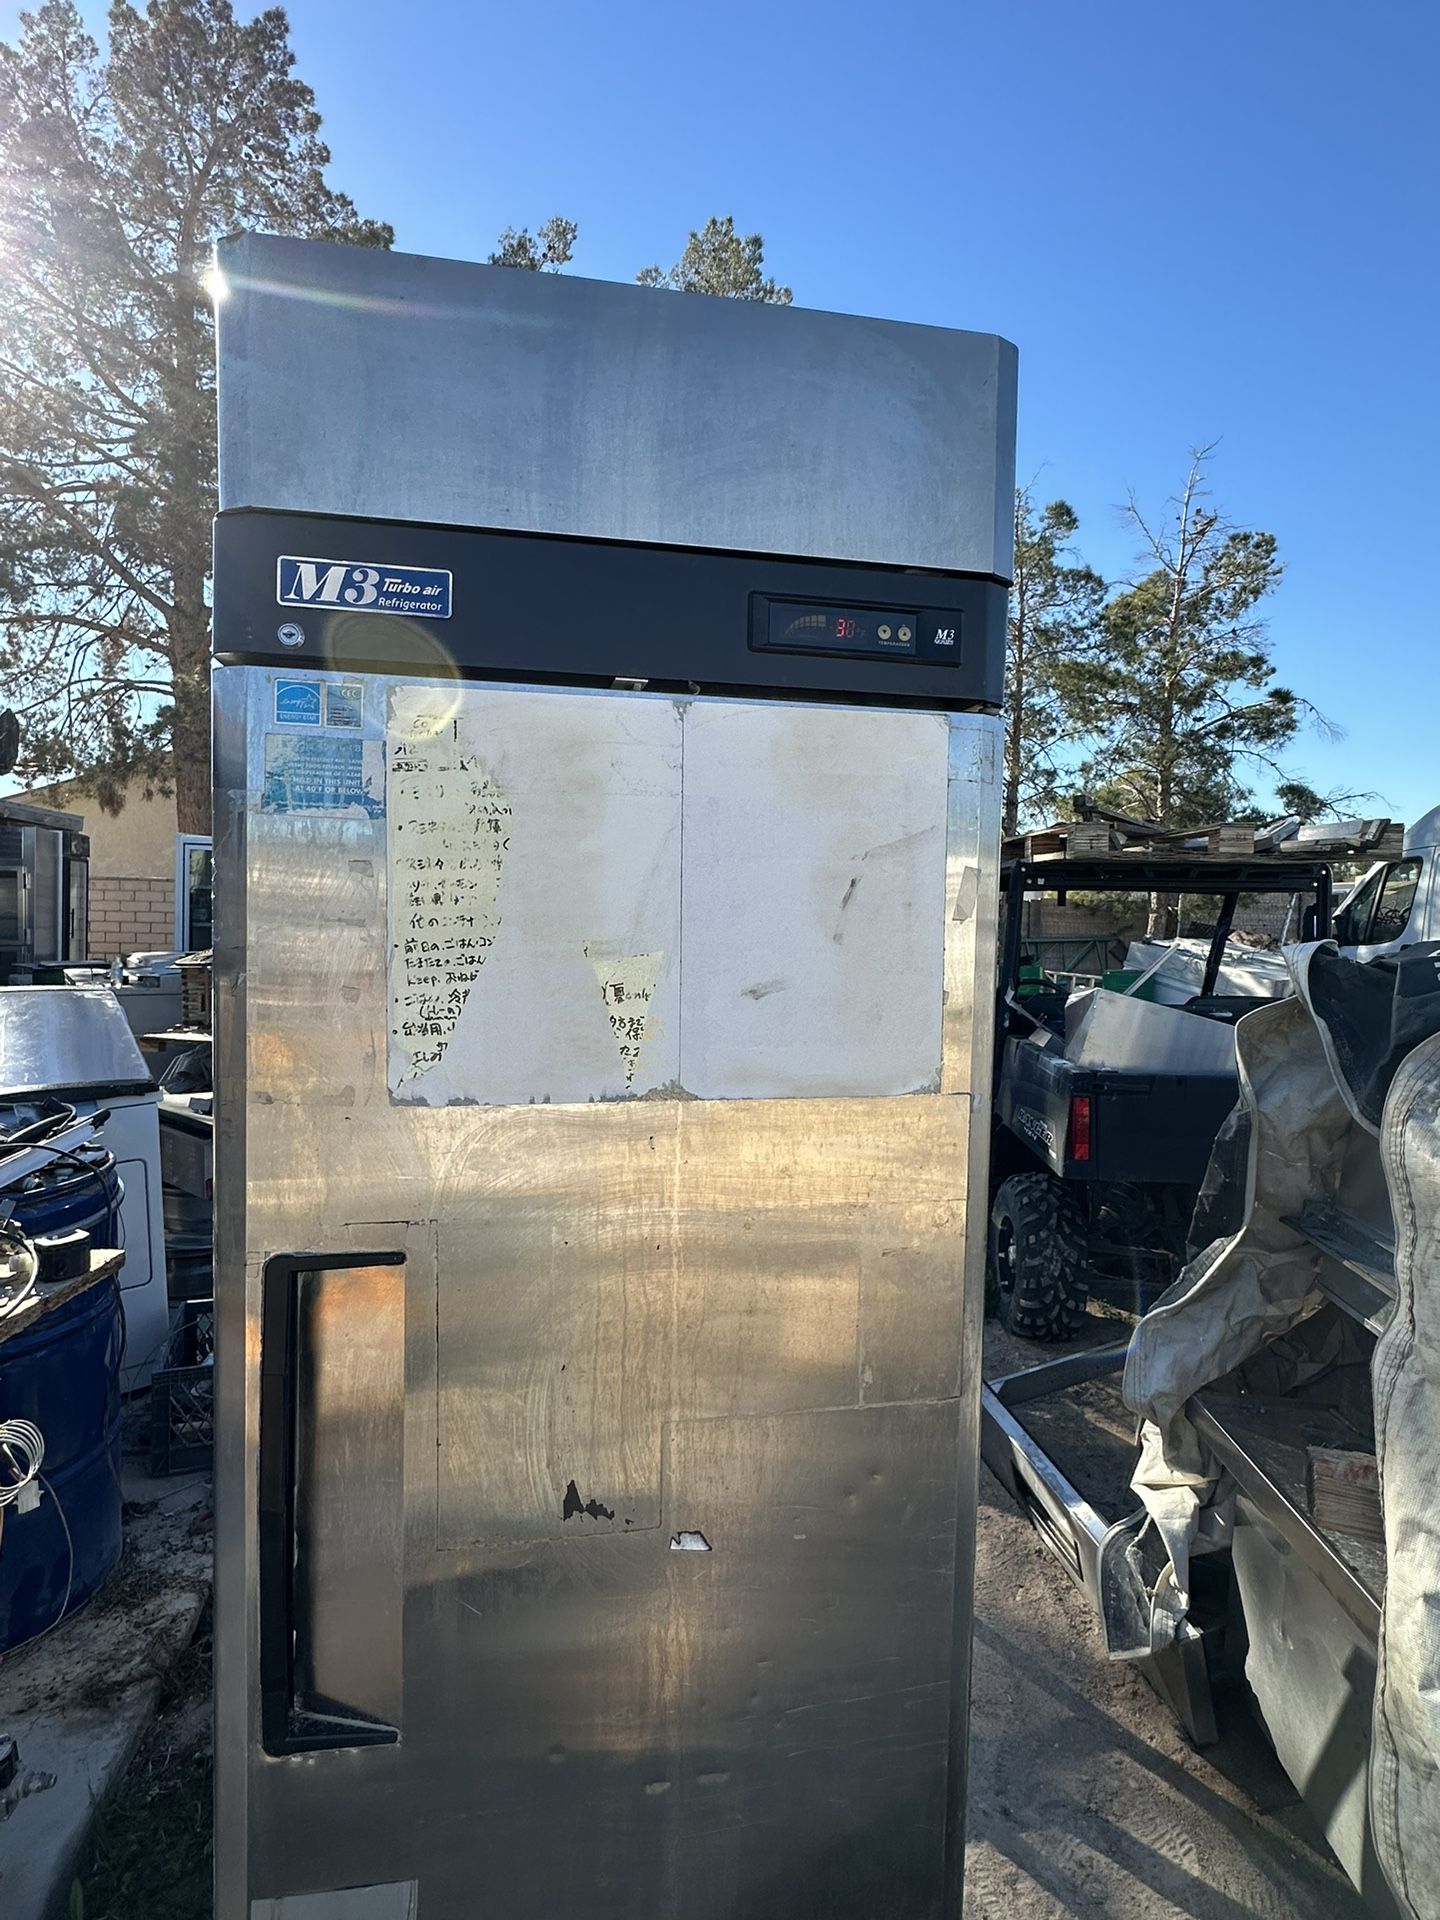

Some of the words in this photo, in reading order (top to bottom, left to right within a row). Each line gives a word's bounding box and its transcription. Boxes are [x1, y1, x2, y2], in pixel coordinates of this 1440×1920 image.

[284, 562, 380, 605] M3
[382, 577, 420, 595] Turbo
[422, 584, 443, 596] air
[378, 597, 442, 611] Refrigerator
[935, 629, 956, 640] M3
[343, 779, 361, 787] UNIT
